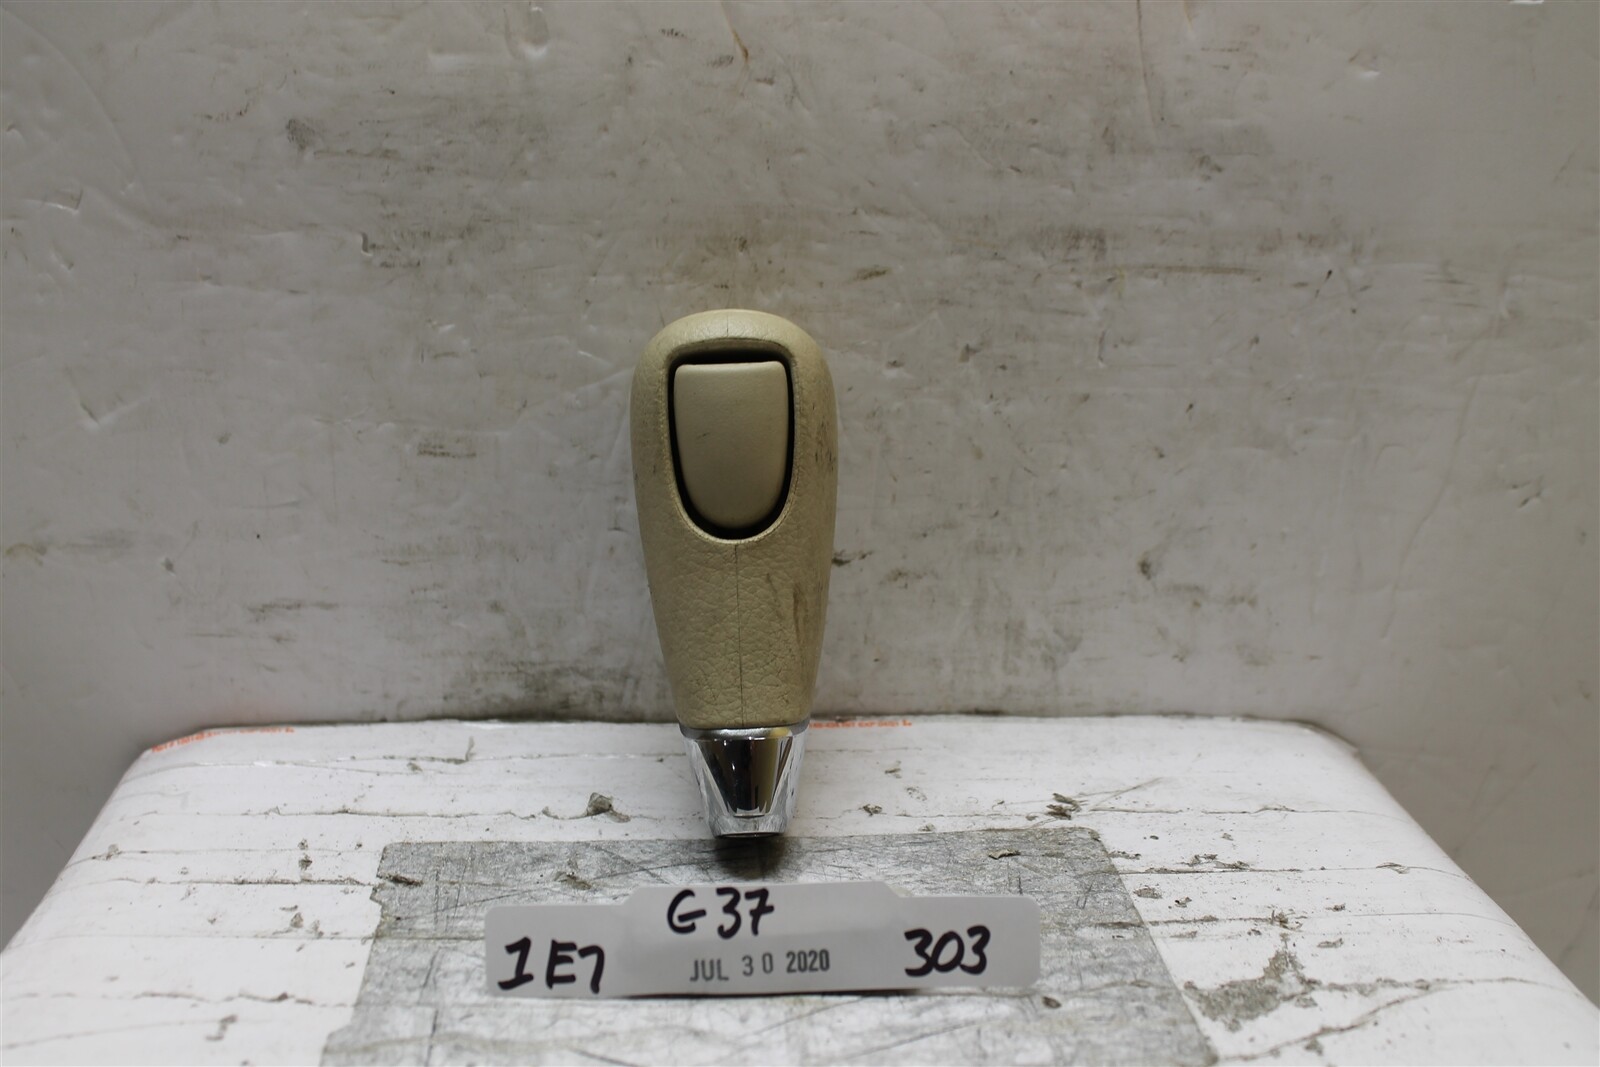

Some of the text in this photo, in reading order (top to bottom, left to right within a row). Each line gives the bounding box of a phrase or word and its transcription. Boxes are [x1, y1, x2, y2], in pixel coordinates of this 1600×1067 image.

[667, 887, 775, 940] G37
[689, 958, 730, 983] JUL
[785, 948, 831, 974] 2020
[904, 925, 991, 977] 303
